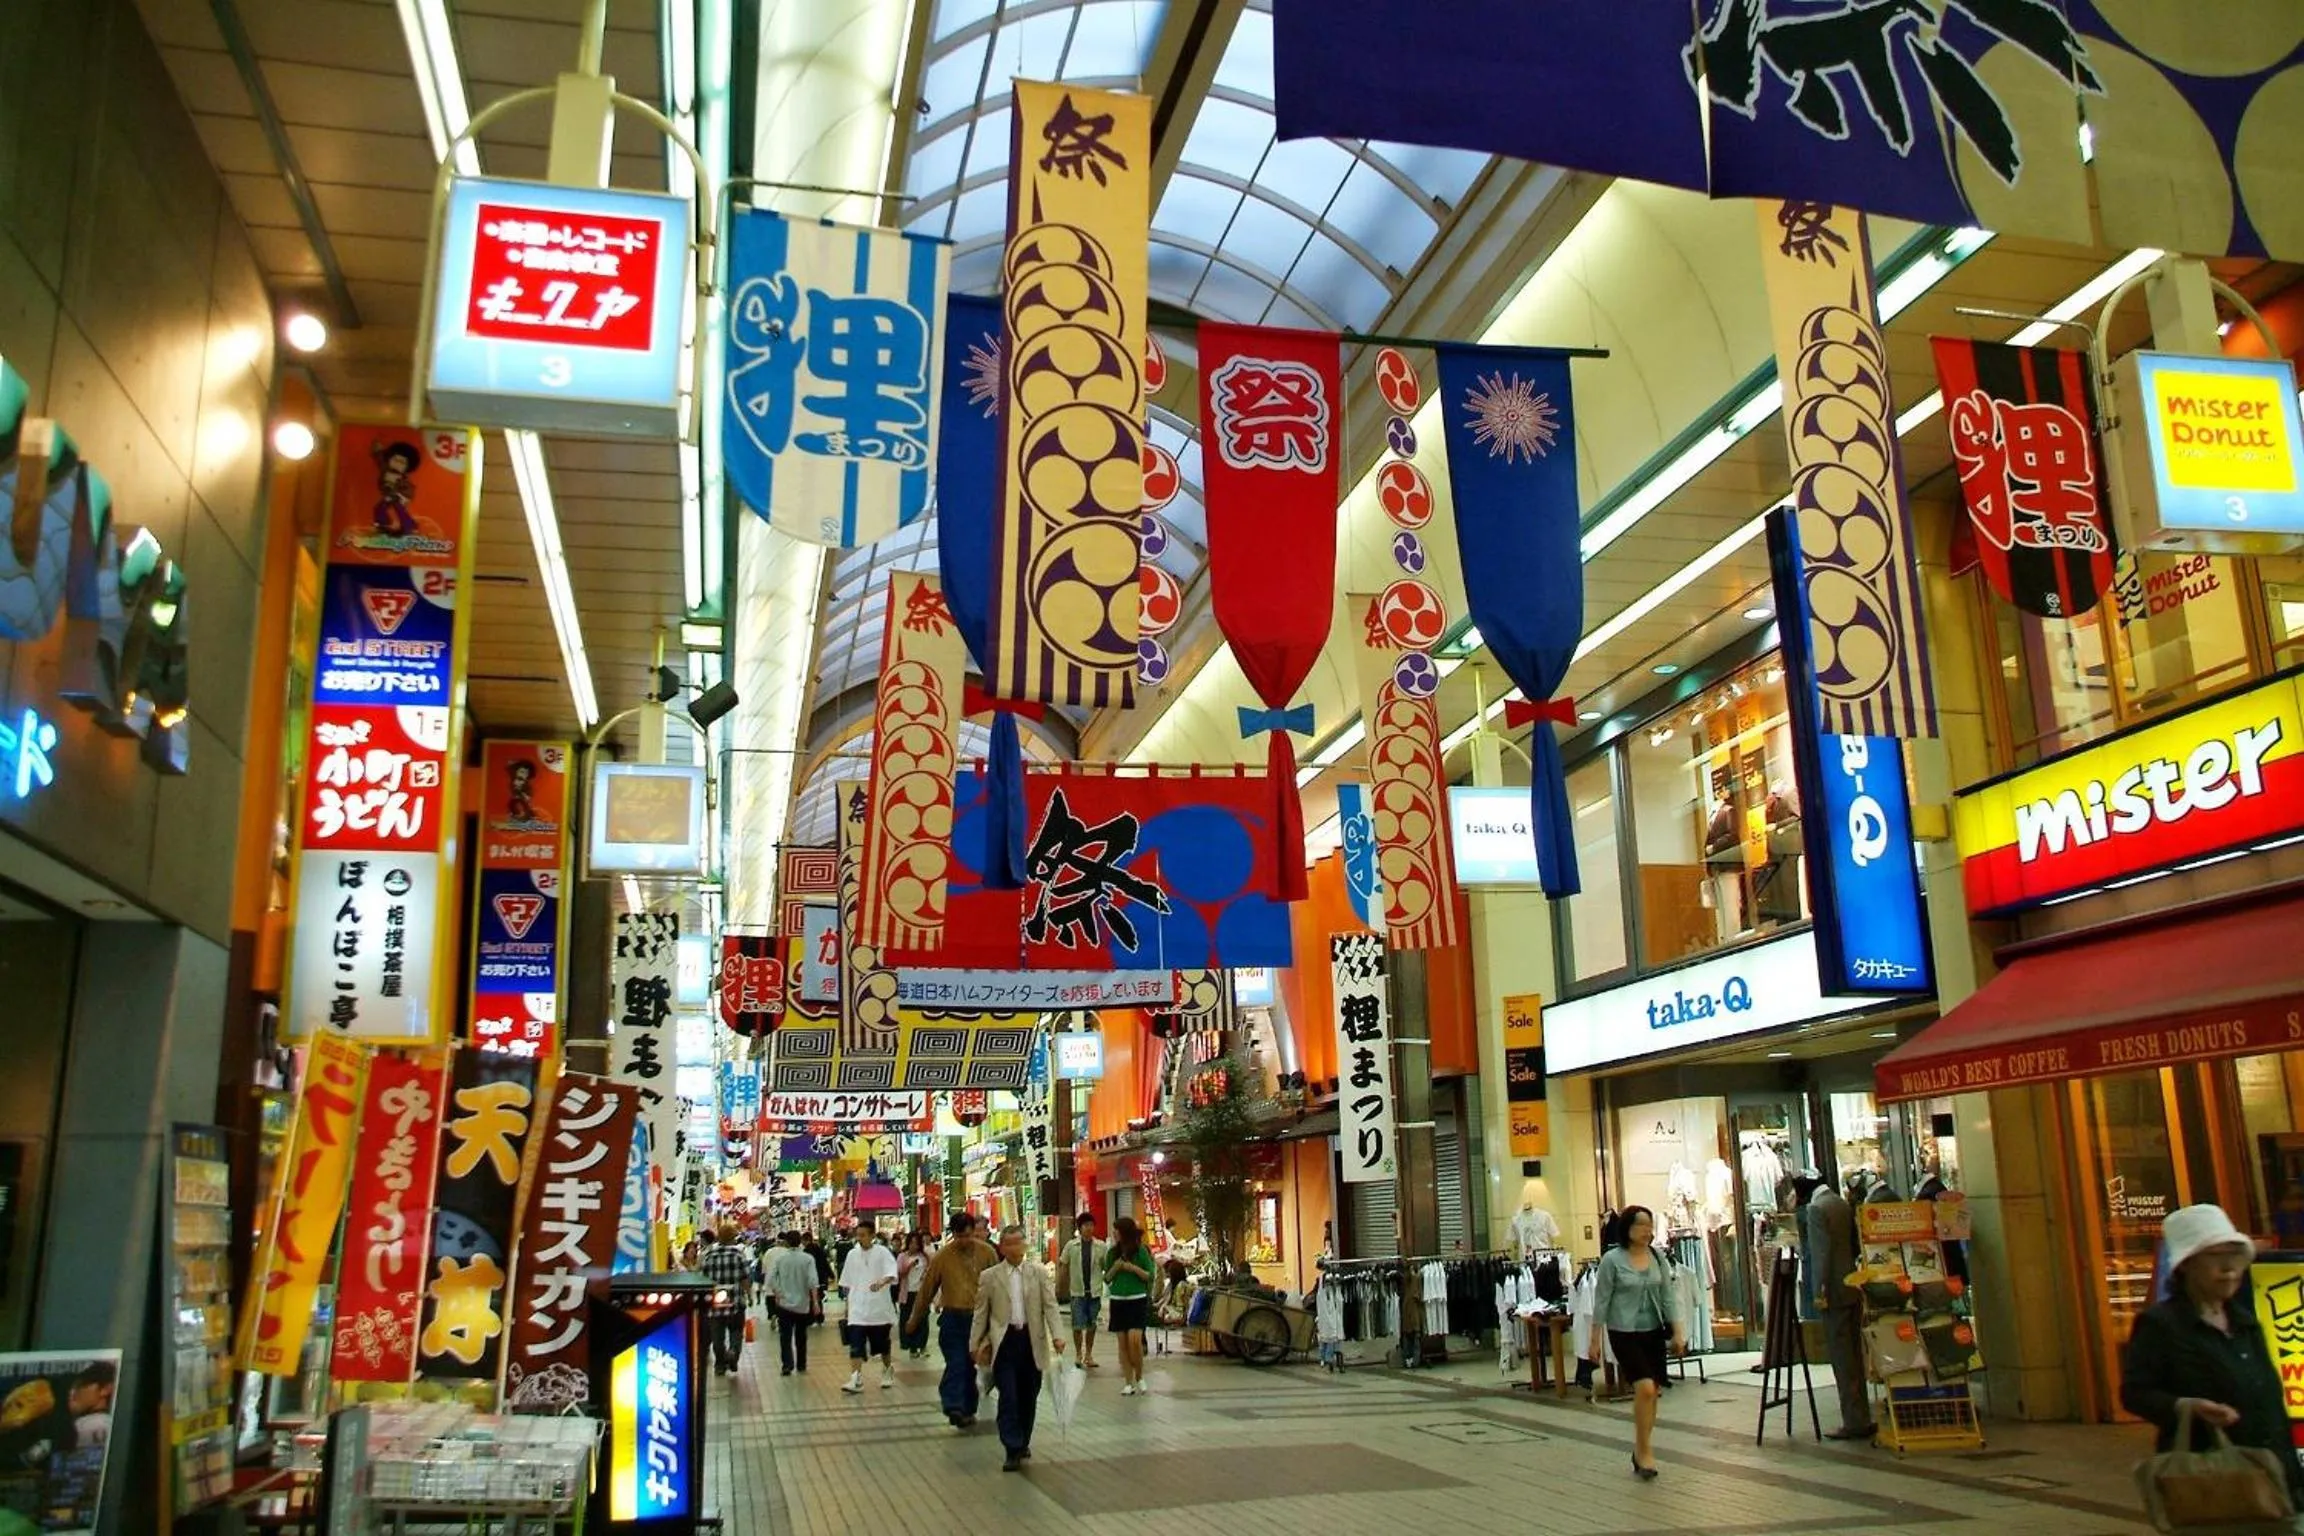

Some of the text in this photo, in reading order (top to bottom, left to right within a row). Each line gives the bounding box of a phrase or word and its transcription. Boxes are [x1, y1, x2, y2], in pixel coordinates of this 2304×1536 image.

[1038, 93, 1130, 188] 祭
[540, 355, 572, 388] 3
[1216, 359, 1327, 470] 祭
[432, 433, 467, 461] 3F
[2171, 422, 2276, 447] Donut
[2225, 495, 2248, 522] 3
[2033, 523, 2097, 547] まつり
[423, 571, 457, 597] 2F
[2149, 574, 2220, 615] Donut
[312, 788, 425, 839] うどん
[1024, 785, 1173, 955] 祭
[1853, 957, 1917, 979] タカキュー
[1648, 976, 1752, 1030] taka-Q
[1507, 1013, 1534, 1029] Sale
[1902, 1064, 1960, 1094] WORLD'S
[1965, 1057, 2002, 1083] BEST
[2008, 1047, 2069, 1075] COFFEE
[2100, 1034, 2161, 1065] FRESH
[2167, 1019, 2247, 1053] DONUTS
[1340, 994, 1383, 1168] 狸まつり
[1509, 1066, 1537, 1082] Sale
[833, 1093, 923, 1119] コンサドーレ
[1512, 1120, 1540, 1137] Sale
[527, 1085, 621, 1356] ジンギスカン
